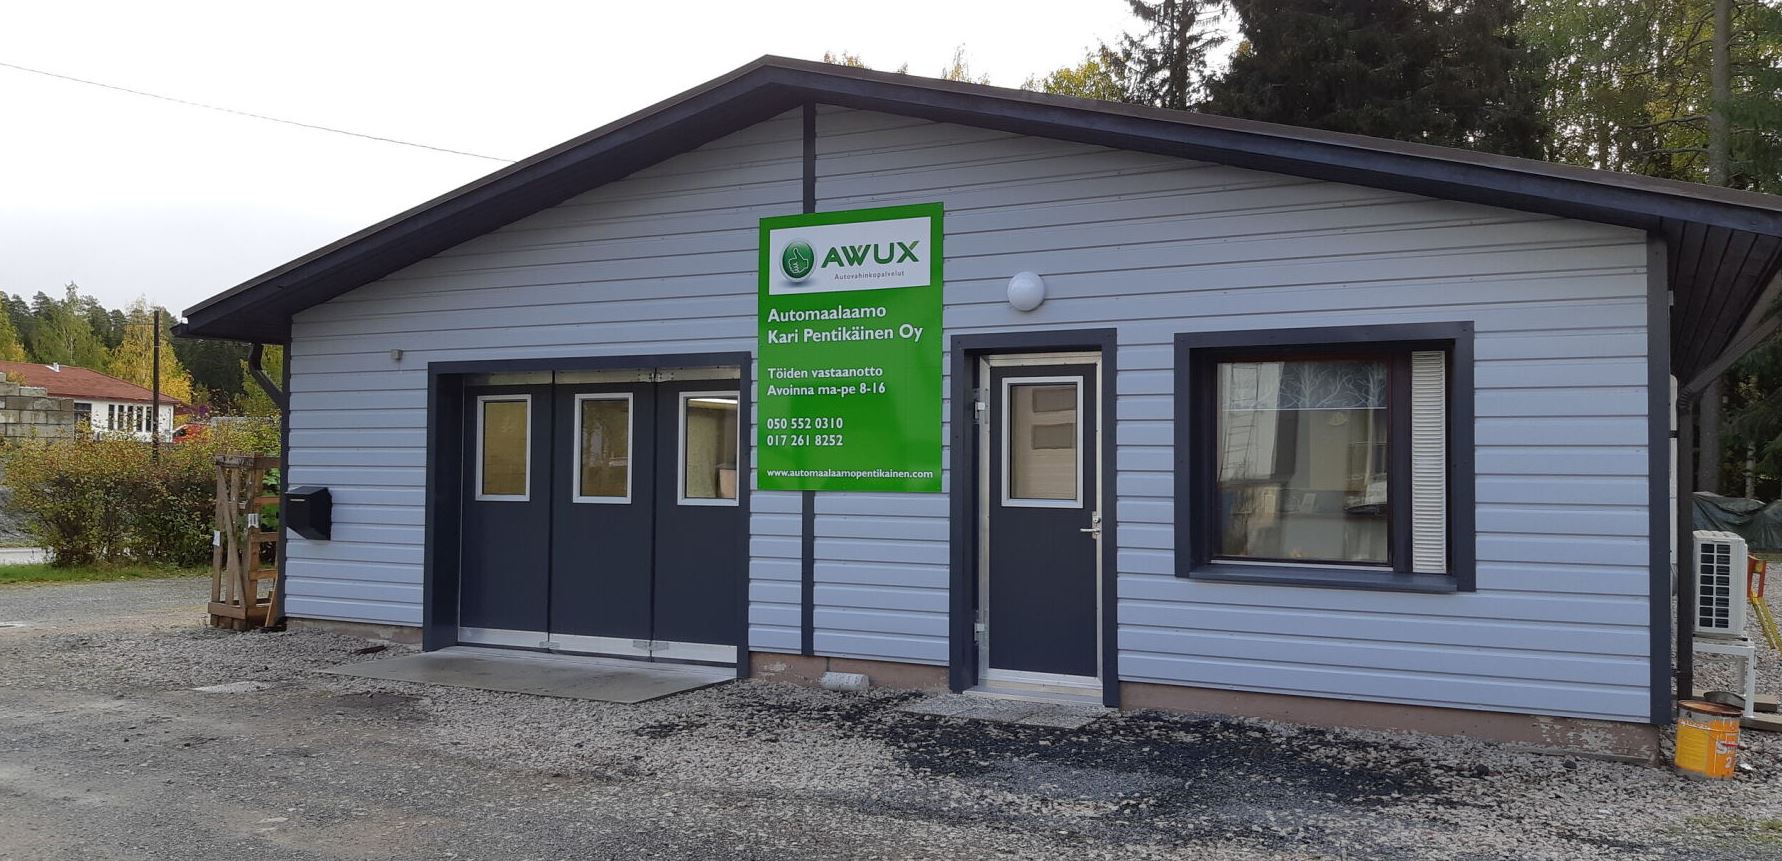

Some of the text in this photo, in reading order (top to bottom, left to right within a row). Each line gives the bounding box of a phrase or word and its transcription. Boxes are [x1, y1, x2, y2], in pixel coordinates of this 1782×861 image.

[821, 240, 920, 269] AWUX
[834, 270, 905, 281] Autovahinkopalvelut
[767, 305, 887, 323] Automaalaamo
[767, 323, 924, 344] Kari Pentikäinen Oy
[767, 366, 883, 379] Töiden vastaanotto
[767, 382, 886, 397] Avoinna ma-pe 8-16
[767, 417, 844, 429] 050 552 0310
[767, 434, 844, 446] 017 261 8252
[767, 468, 934, 479] www.automaalaamopentikainen.com
